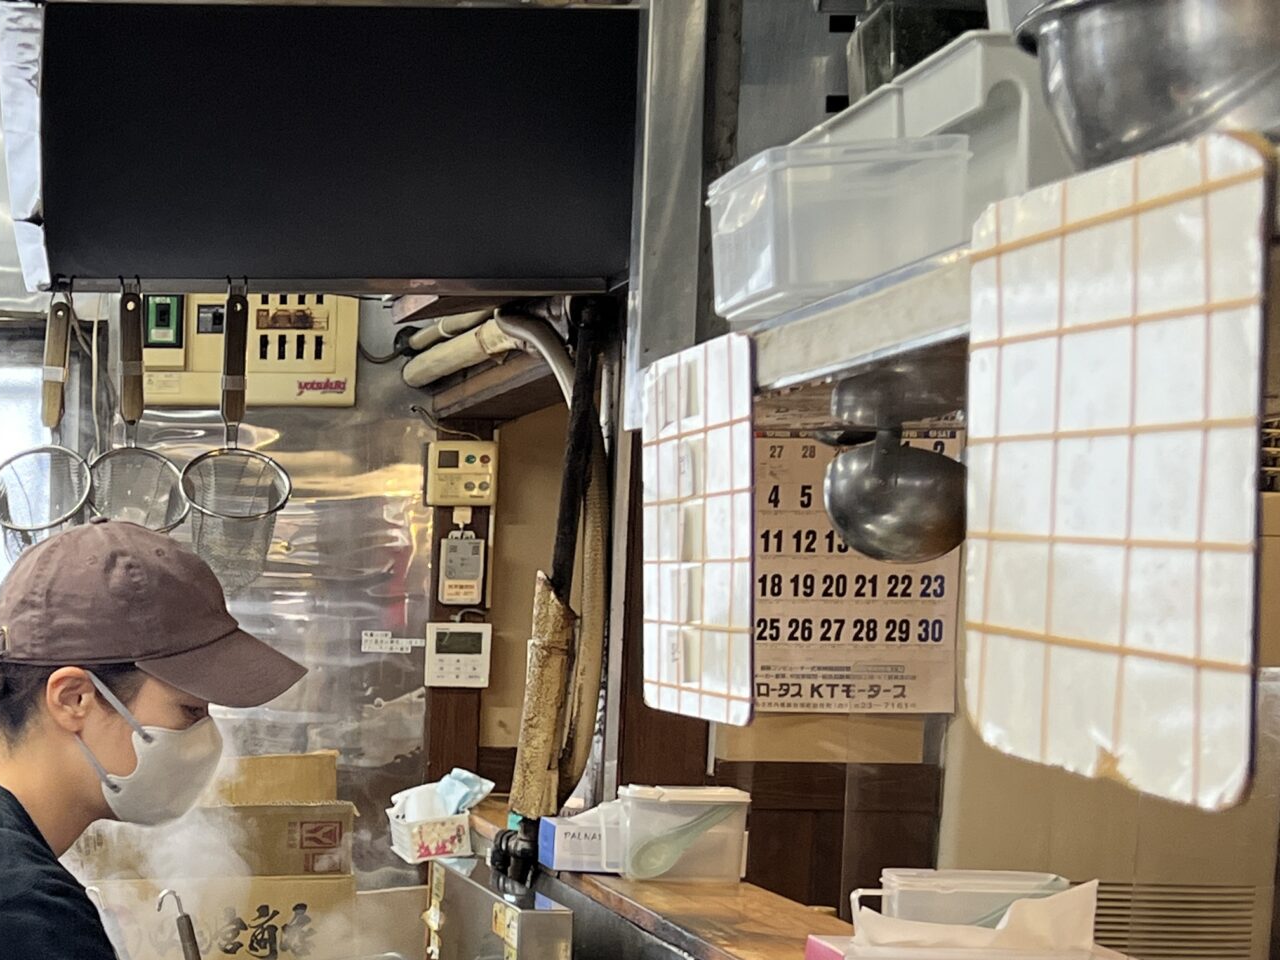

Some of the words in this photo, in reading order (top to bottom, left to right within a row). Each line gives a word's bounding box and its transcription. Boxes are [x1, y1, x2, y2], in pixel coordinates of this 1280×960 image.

[770, 446, 783, 458] 27
[802, 446, 815, 458] 28
[768, 485, 780, 508] 4
[800, 485, 812, 508] 5
[760, 530, 783, 553] 11
[792, 530, 817, 553] 12
[758, 574, 782, 597] 18
[790, 574, 814, 597] 19
[822, 574, 847, 598] 20
[854, 574, 878, 598] 21
[887, 574, 912, 598] 22
[920, 574, 945, 598] 23
[756, 618, 780, 641] 25
[787, 618, 813, 641] 26
[820, 618, 845, 642] 27
[852, 618, 877, 642] 28
[885, 618, 910, 643] 29
[917, 619, 943, 643] 30
[756, 683, 803, 699] ロータス
[810, 683, 907, 699] KTモータース
